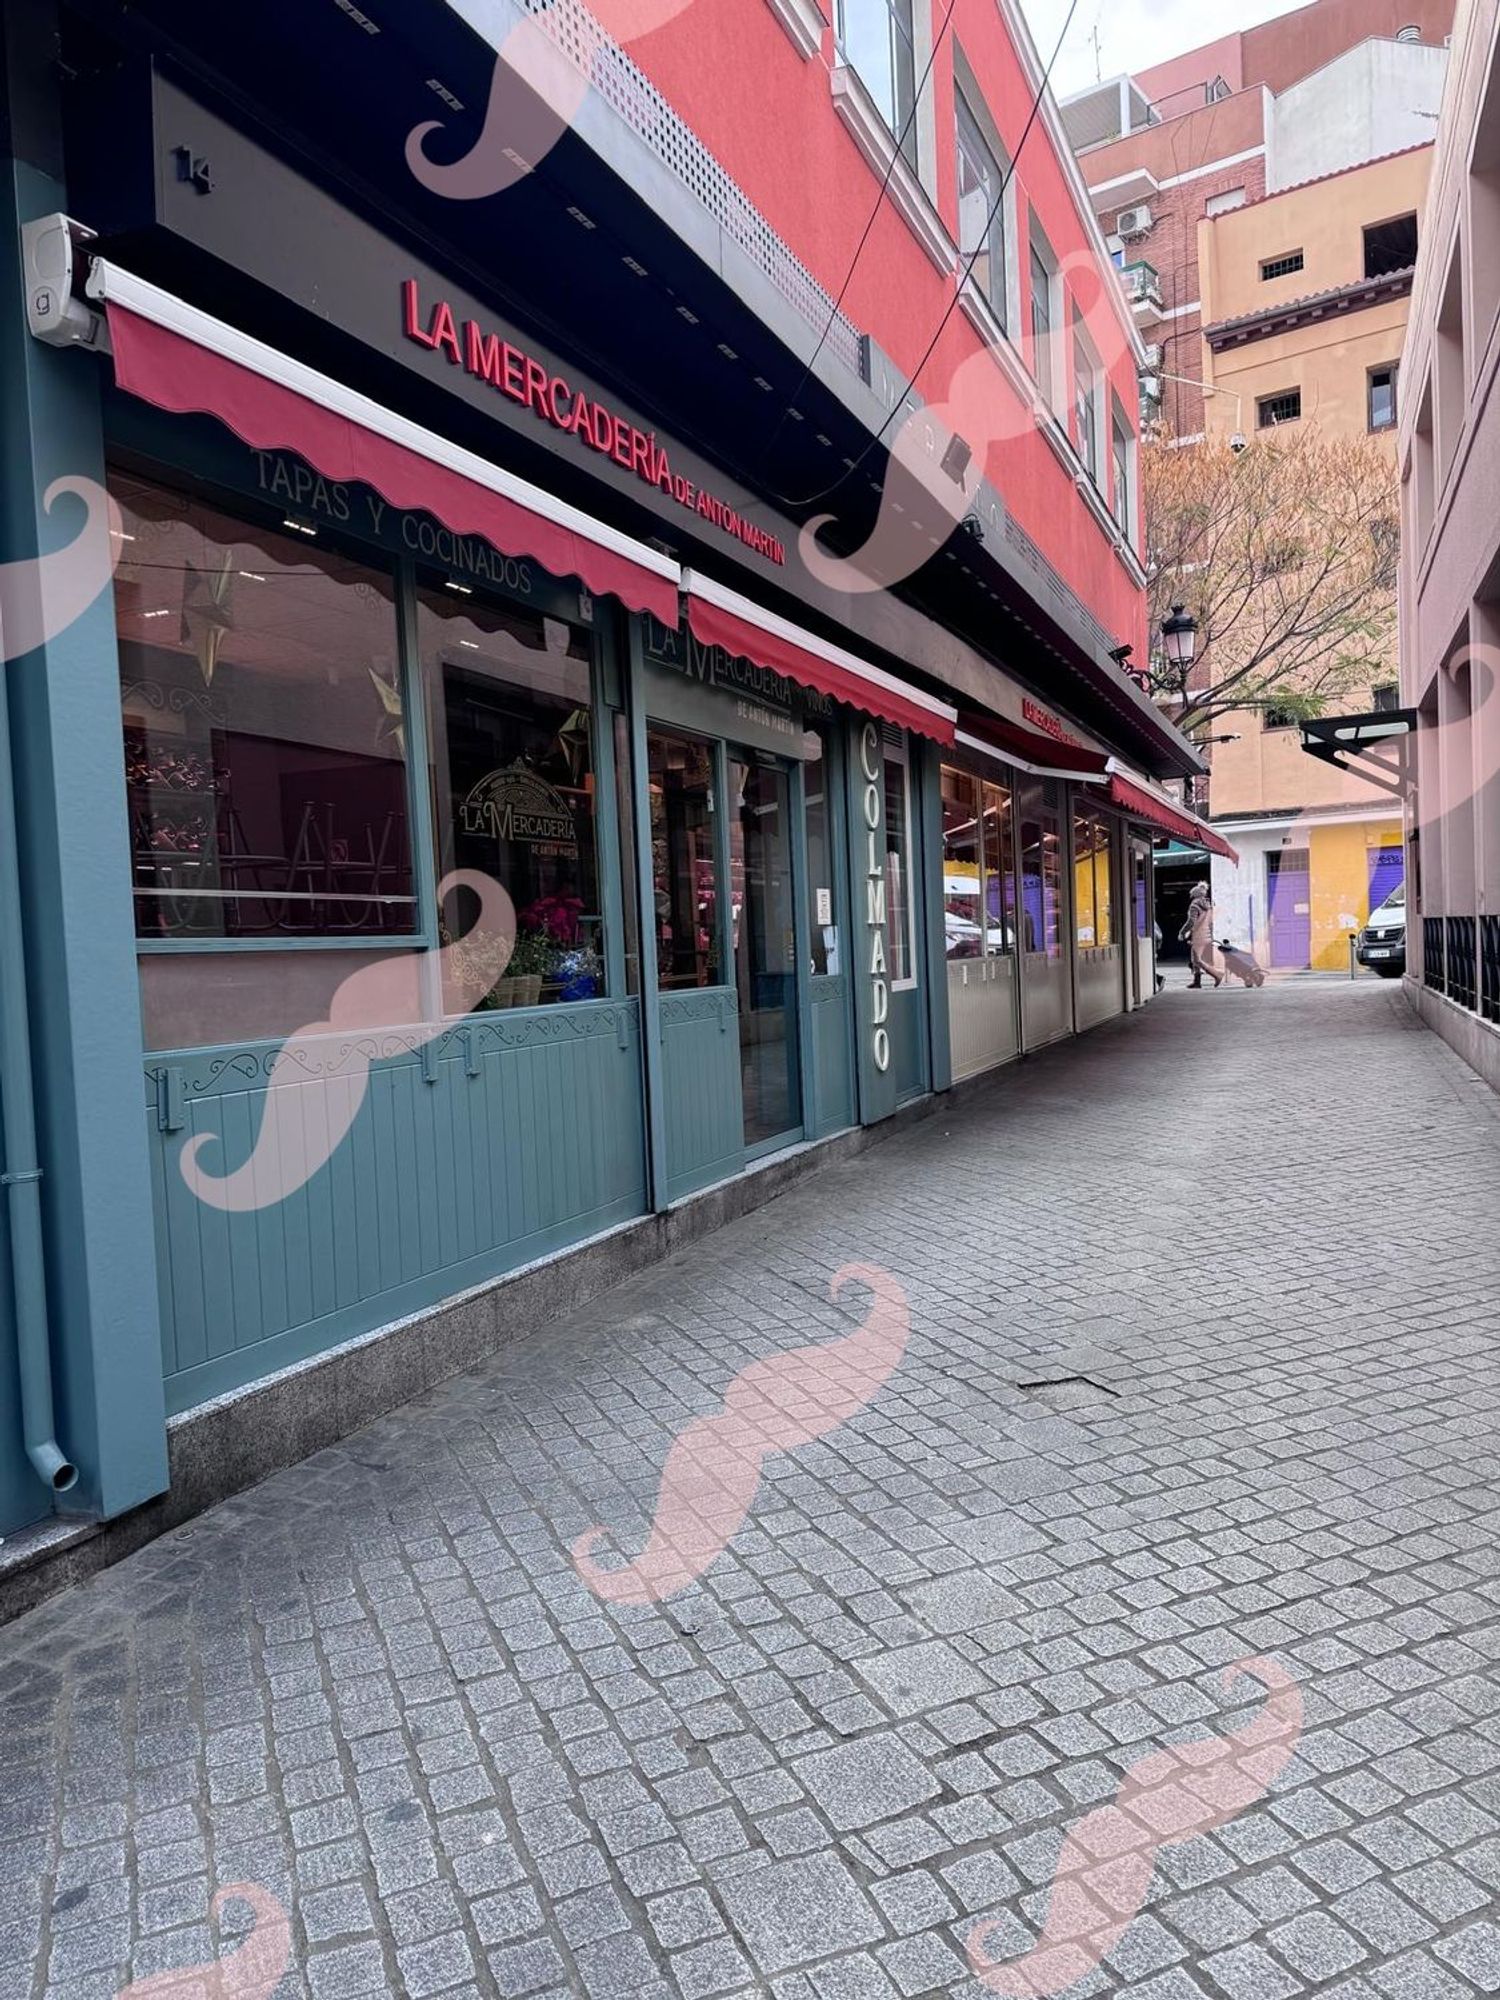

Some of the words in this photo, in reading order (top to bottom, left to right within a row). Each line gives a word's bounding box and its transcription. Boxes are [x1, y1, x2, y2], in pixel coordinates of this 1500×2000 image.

[254, 448, 351, 521] TAPAS
[367, 496, 386, 535] Y
[402, 515, 533, 594] COCINADOS
[404, 278, 462, 364] LA
[464, 319, 673, 494] MERCADERÍA
[673, 474, 696, 511] DE
[694, 489, 742, 540] ANTÓN
[740, 519, 786, 566] MARTÍN
[459, 804, 486, 832] LA
[860, 722, 891, 1072] COLMADO
